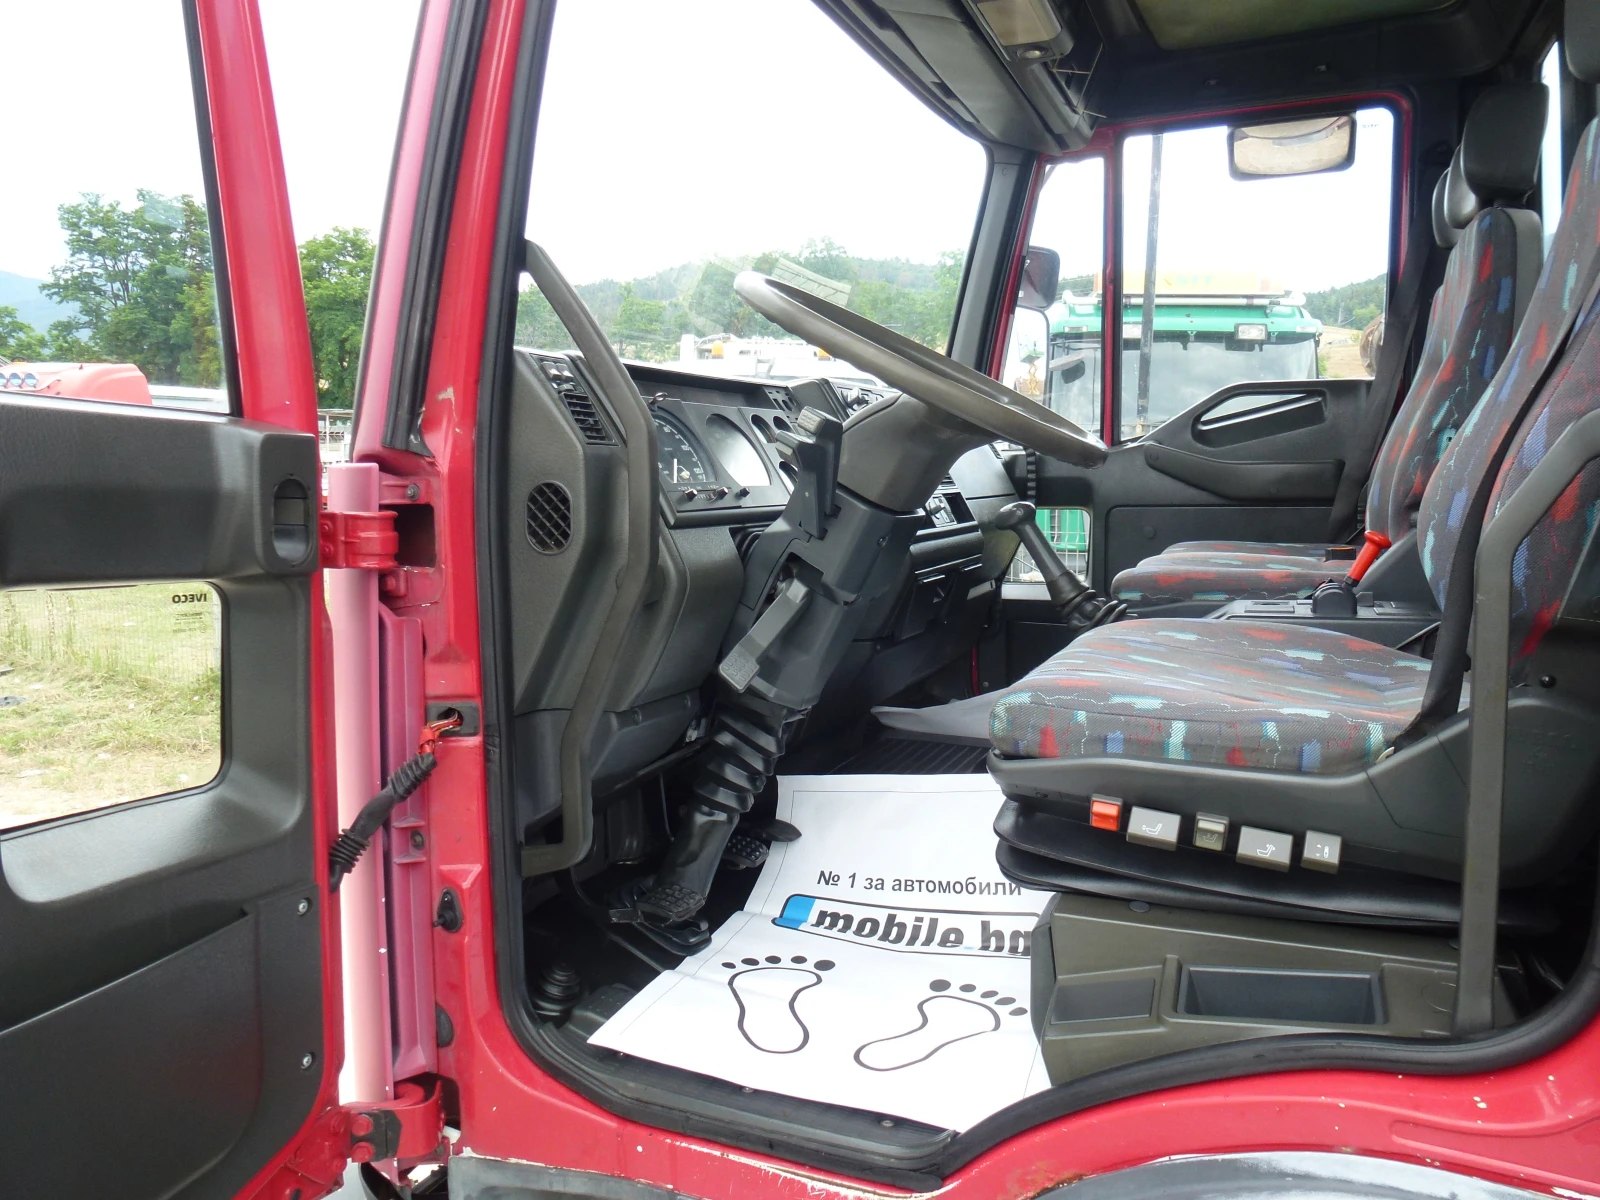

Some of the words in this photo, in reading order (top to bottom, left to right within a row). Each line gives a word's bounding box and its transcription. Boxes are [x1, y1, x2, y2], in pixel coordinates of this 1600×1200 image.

[817, 870, 841, 887] №
[848, 872, 856, 888] 1
[863, 876, 885, 891] за
[891, 876, 1022, 896] автомобили
